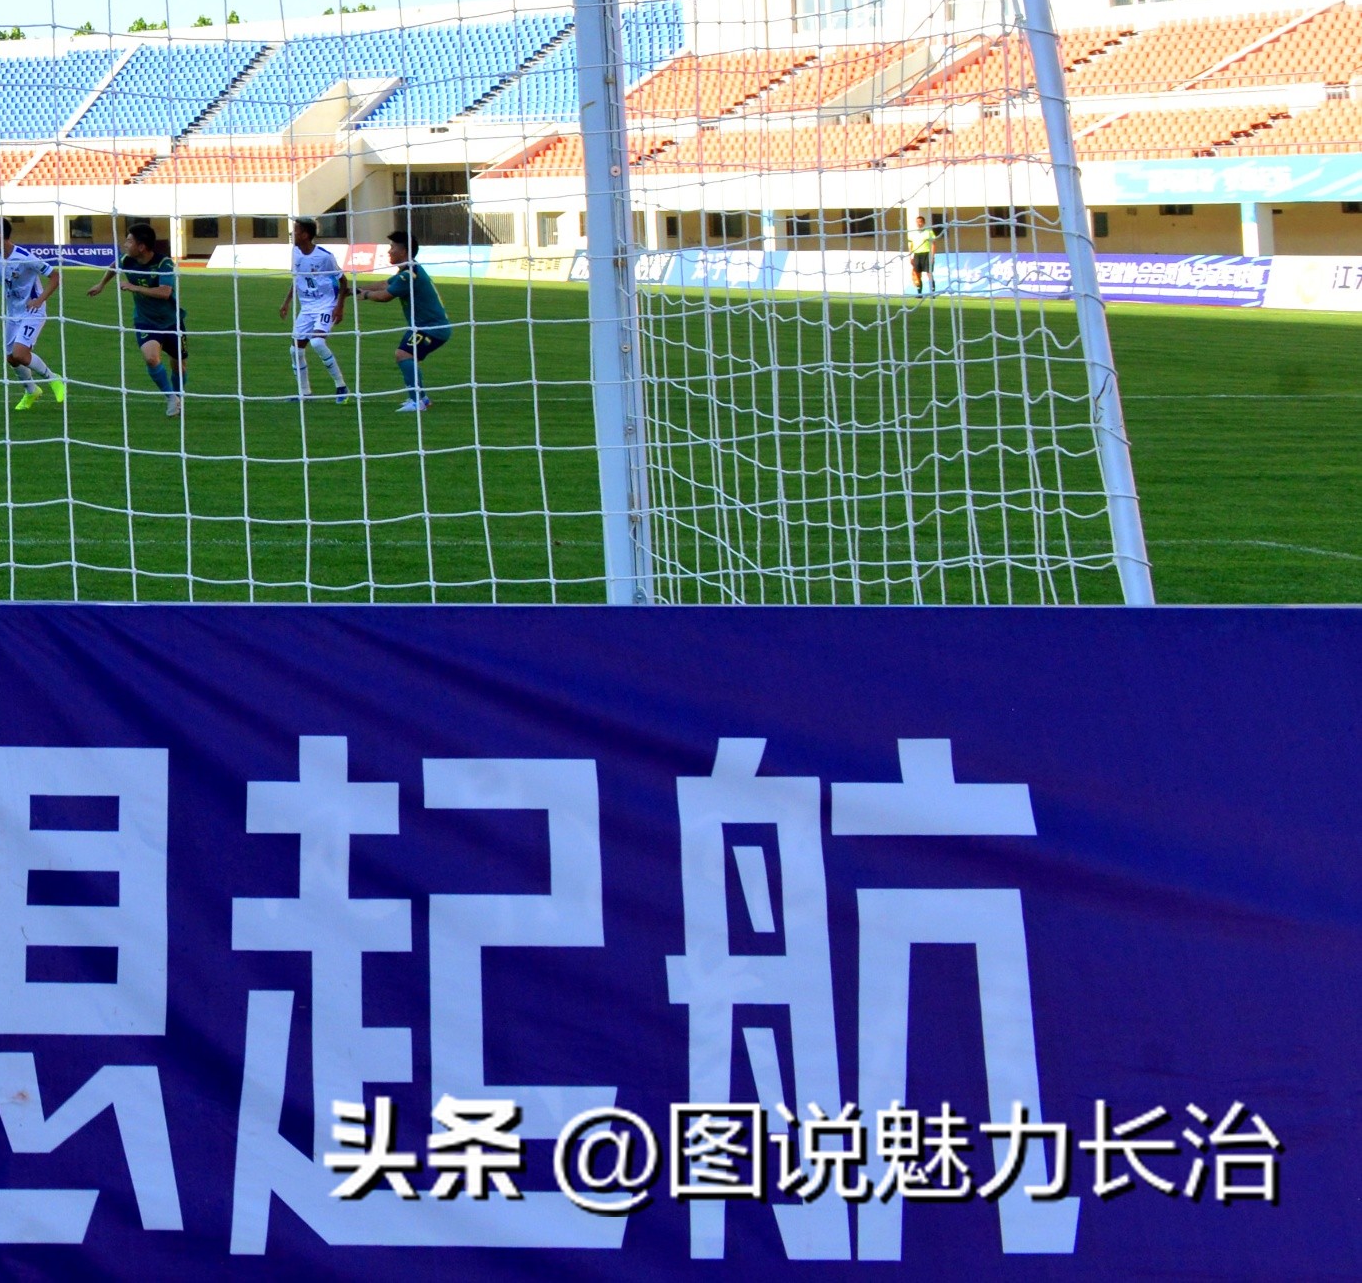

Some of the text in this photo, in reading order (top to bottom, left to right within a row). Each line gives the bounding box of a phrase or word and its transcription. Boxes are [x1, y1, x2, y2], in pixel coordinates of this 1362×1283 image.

[79, 248, 114, 256] CENTER
[319, 313, 331, 324] 10
[23, 324, 36, 337] 17
